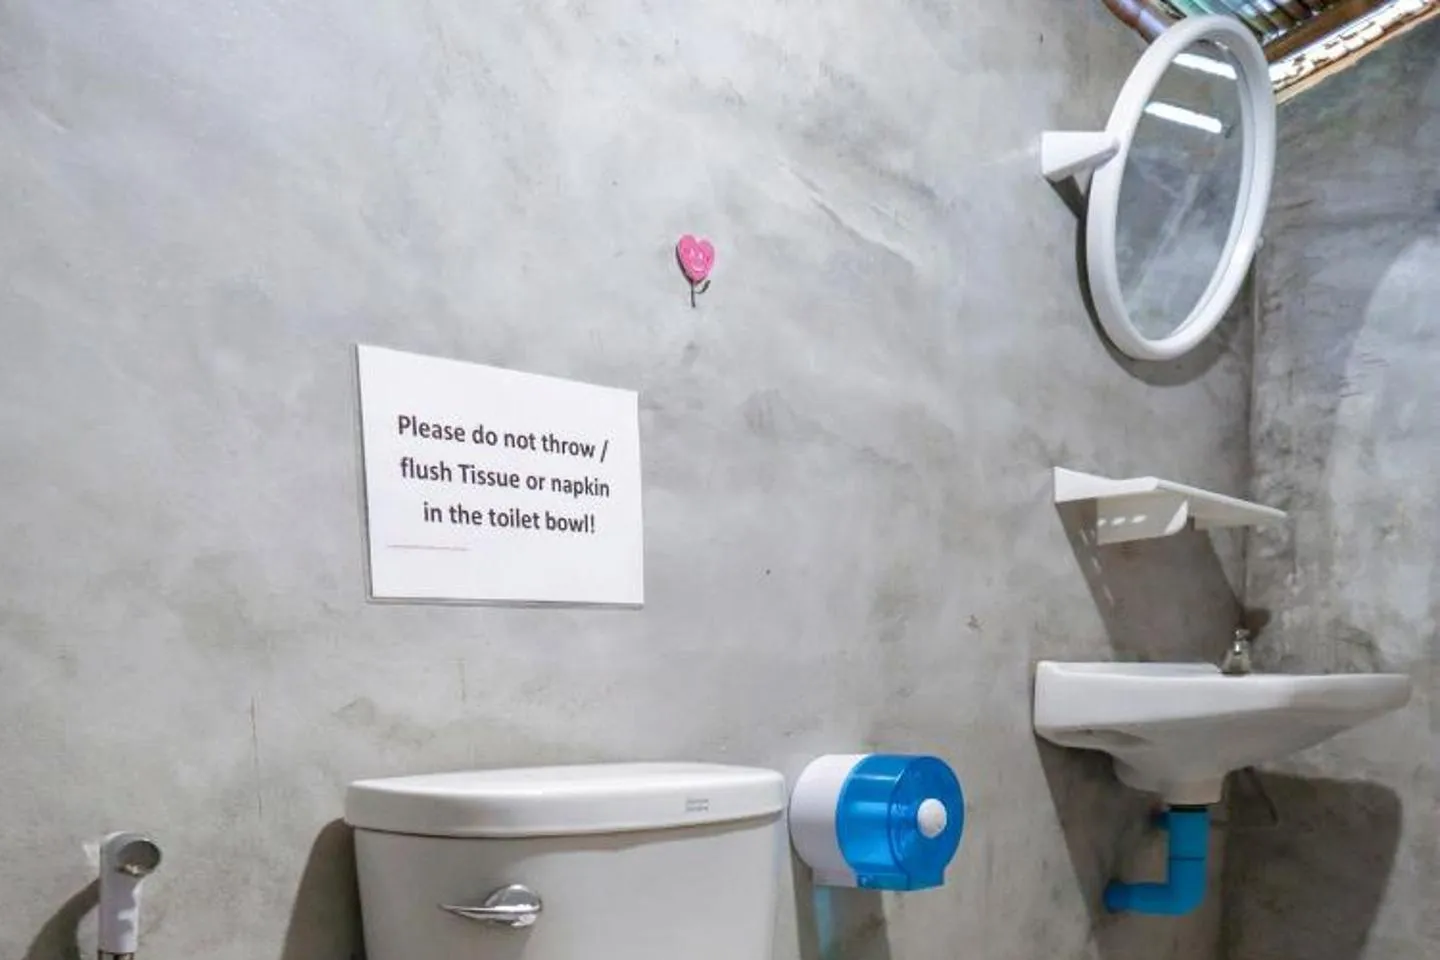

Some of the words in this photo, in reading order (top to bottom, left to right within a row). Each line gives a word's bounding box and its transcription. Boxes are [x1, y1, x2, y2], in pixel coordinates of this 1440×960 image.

[398, 414, 466, 443] Please
[471, 424, 498, 447] do
[503, 431, 537, 451] not
[540, 433, 596, 458] throw
[599, 439, 609, 463] /
[399, 456, 453, 483] flush
[457, 463, 521, 489] Tissue
[525, 475, 546, 491] or
[550, 475, 610, 499] napkin
[422, 500, 443, 523] in
[448, 503, 483, 526] the
[487, 507, 541, 530] toilet
[544, 510, 596, 534] bowl!
